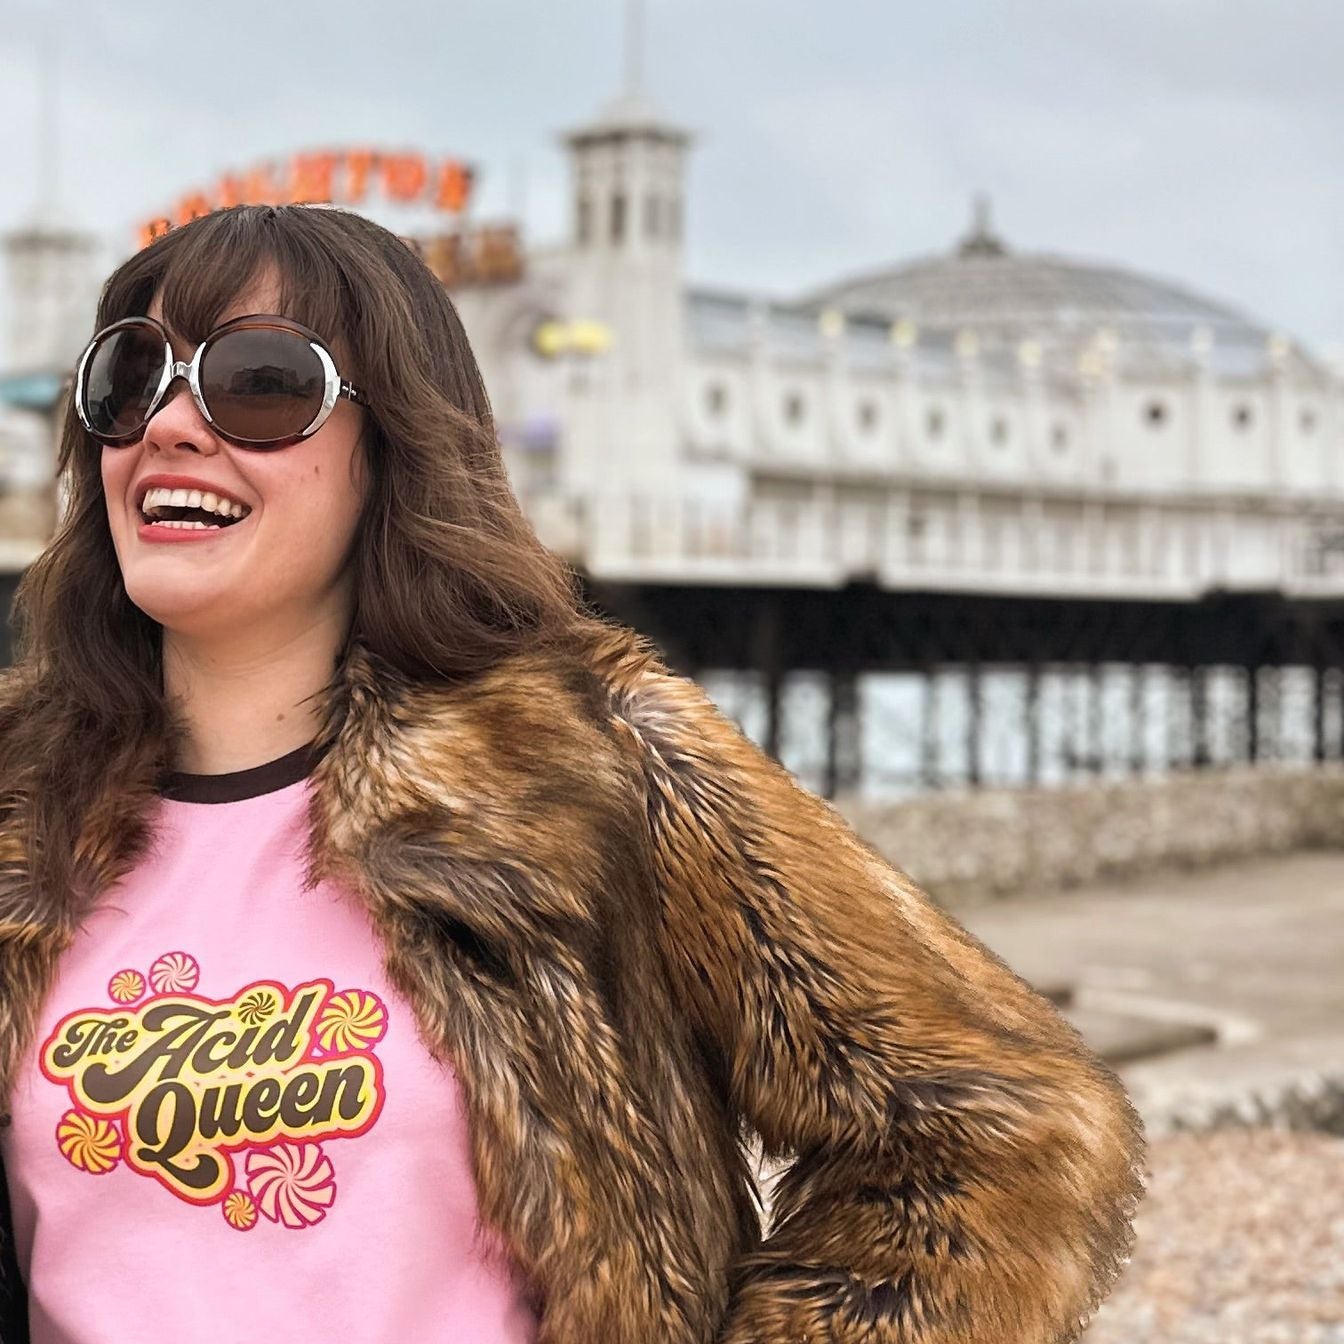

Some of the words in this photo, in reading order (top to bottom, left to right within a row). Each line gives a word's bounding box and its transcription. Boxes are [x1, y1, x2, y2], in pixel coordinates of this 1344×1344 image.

[52, 1017, 138, 1069] The
[82, 990, 321, 1104] Acid
[136, 1064, 367, 1190] Queen
